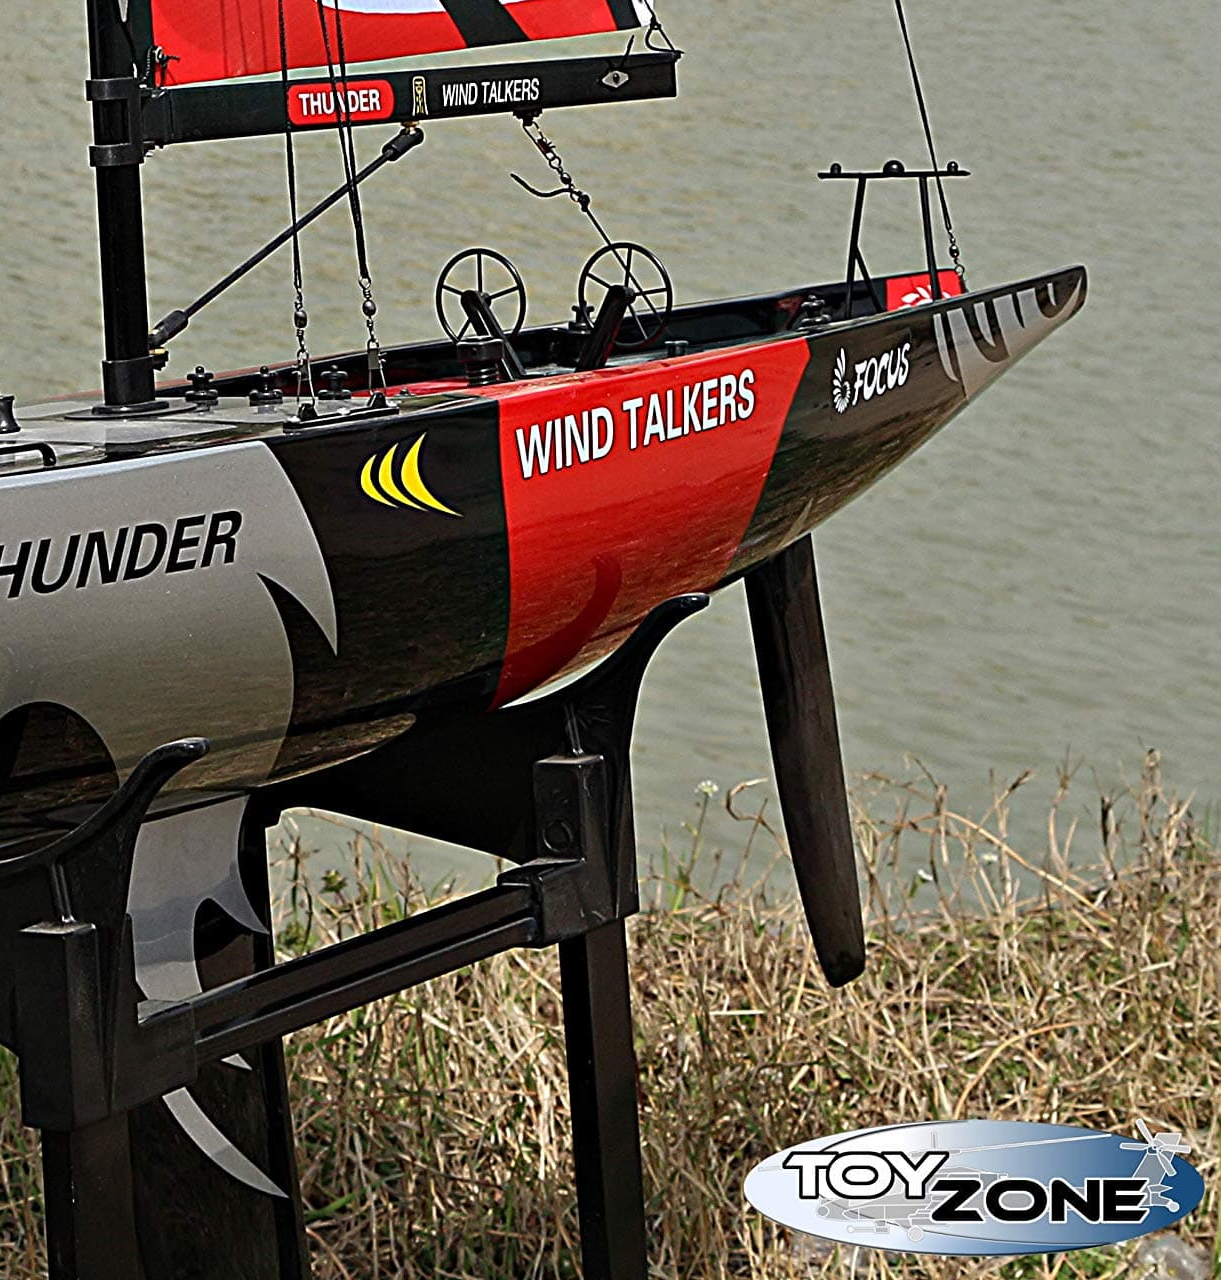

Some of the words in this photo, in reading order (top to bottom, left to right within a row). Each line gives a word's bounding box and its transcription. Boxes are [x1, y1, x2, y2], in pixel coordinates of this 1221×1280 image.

[442, 82, 479, 107] WIND
[481, 78, 540, 104] TALKERS
[853, 342, 911, 404] FOCUS
[516, 406, 614, 480] WIND
[622, 368, 756, 451] TALKERS
